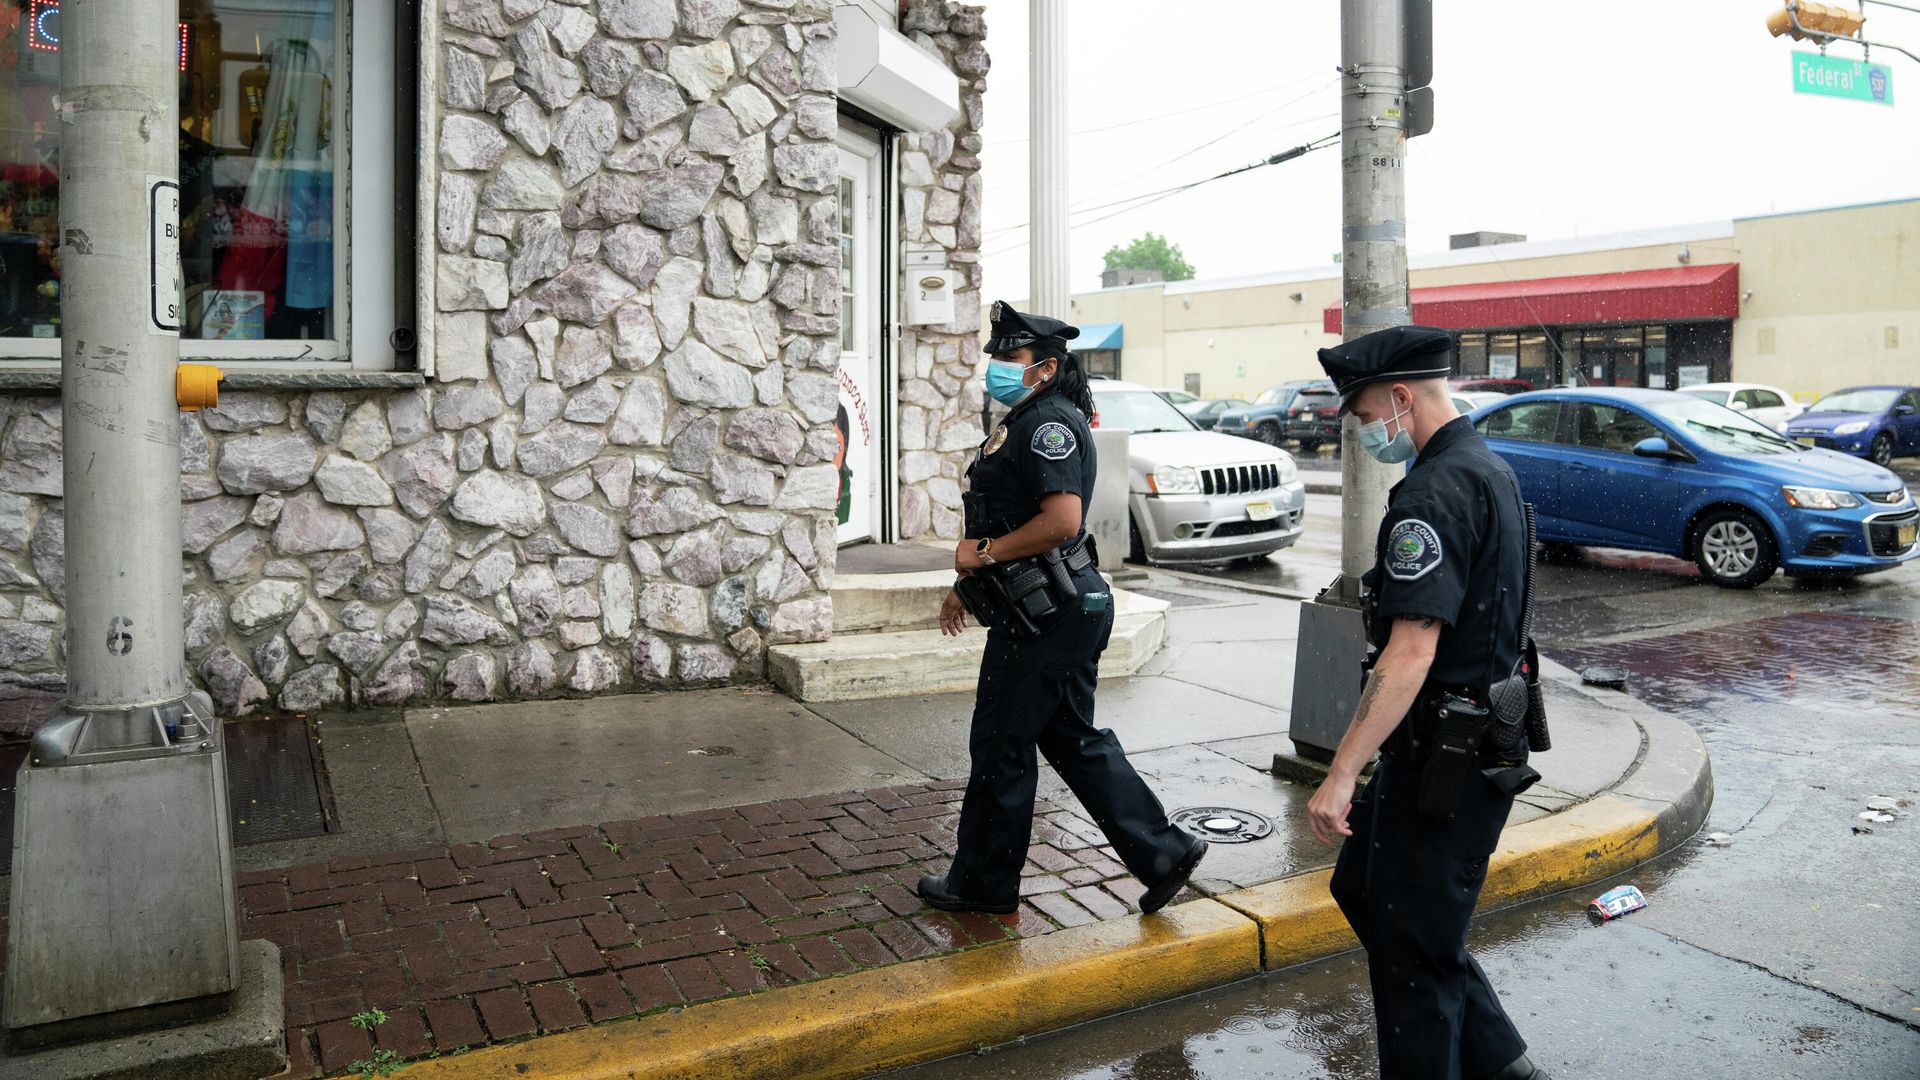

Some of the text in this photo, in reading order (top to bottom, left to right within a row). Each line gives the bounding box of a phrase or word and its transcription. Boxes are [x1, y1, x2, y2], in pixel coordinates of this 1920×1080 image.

[1799, 61, 1853, 90] Federal
[921, 290, 927, 301] 2
[1053, 425, 1074, 442] COUNTY
[1413, 524, 1439, 556] COUNTY
[1392, 562, 1422, 571] POLICE
[106, 616, 133, 657] 6
